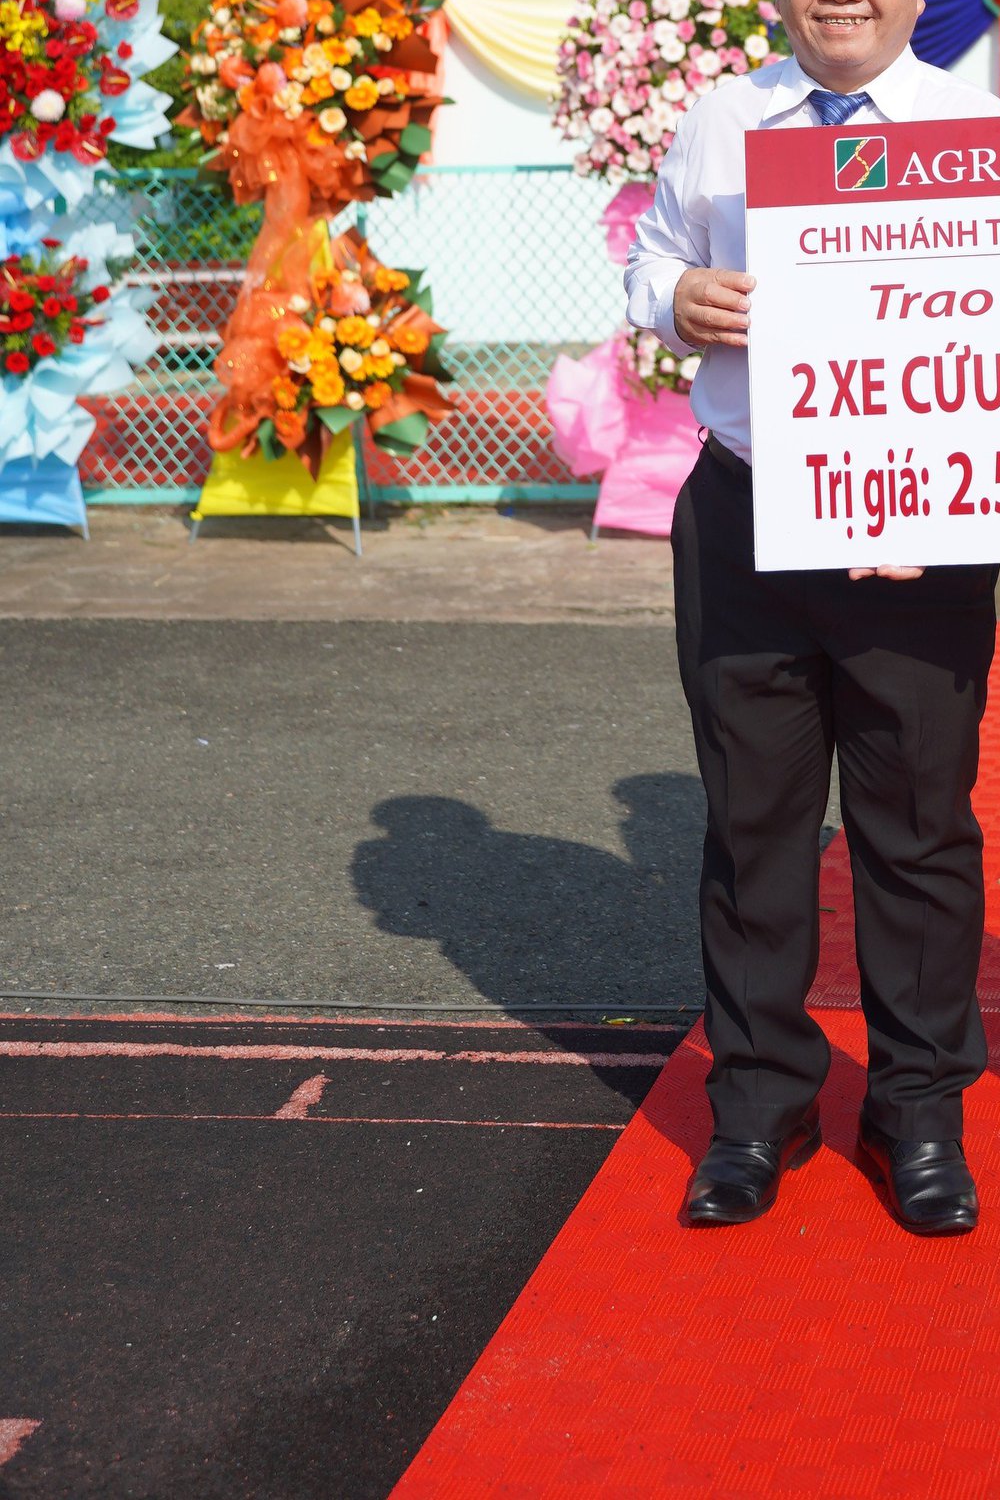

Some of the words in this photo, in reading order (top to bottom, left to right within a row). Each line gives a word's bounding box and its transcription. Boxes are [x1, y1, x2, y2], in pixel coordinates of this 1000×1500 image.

[799, 226, 851, 255] CHI
[861, 216, 978, 252] NHÁNH
[869, 283, 994, 320] Trao
[791, 362, 818, 419] 2
[828, 358, 888, 417] XE
[805, 450, 853, 540] Trị
[864, 447, 931, 538] giá:
